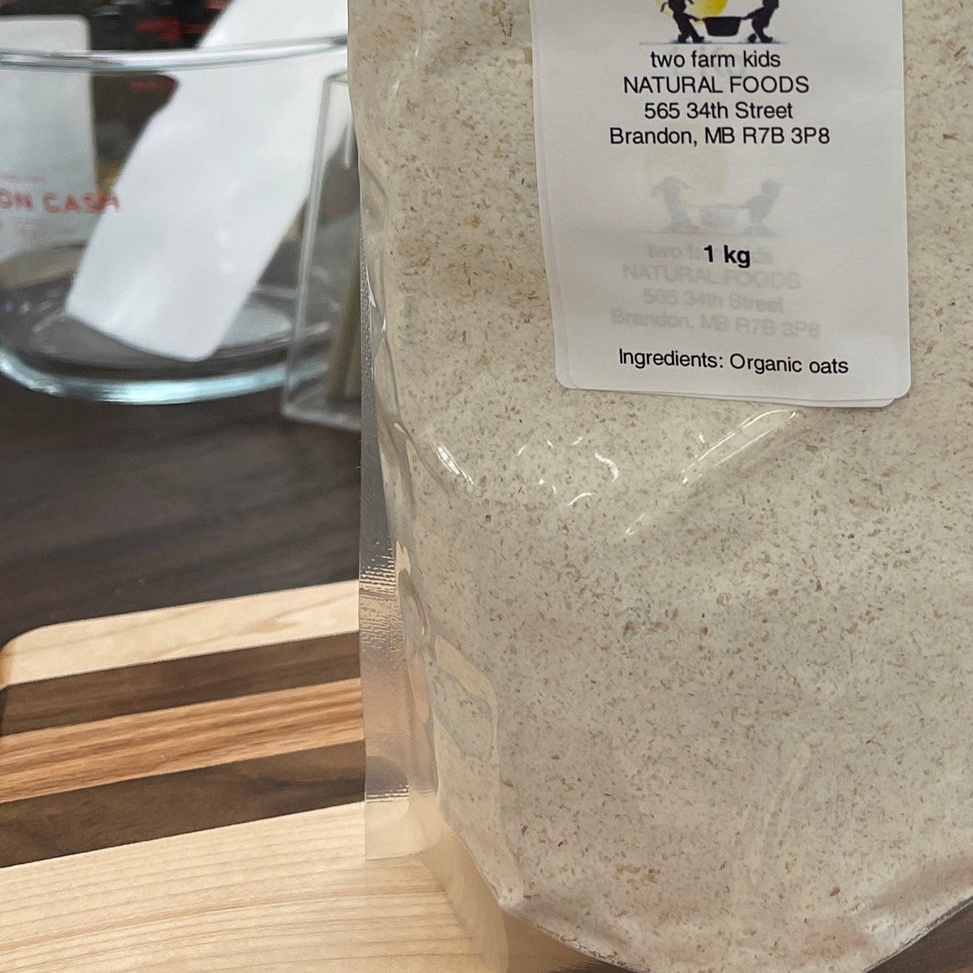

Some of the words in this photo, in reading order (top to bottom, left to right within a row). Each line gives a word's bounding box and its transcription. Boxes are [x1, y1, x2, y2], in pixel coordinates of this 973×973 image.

[650, 51, 686, 69] two
[690, 49, 736, 68] farm
[743, 49, 781, 68] kids
[623, 75, 724, 94] NATURAL
[729, 75, 810, 94] FOODS
[644, 102, 681, 120] 565
[686, 101, 729, 120] 34th
[735, 101, 794, 119] Street
[609, 126, 698, 147] Brandon,
[704, 126, 736, 144] MB
[742, 126, 785, 144] R7B
[791, 126, 830, 145] 3P8
[703, 244, 714, 263] 1
[723, 244, 751, 269] kg
[618, 347, 724, 370] Ingredients:
[729, 352, 803, 375] Organic
[808, 358, 849, 374] oats
